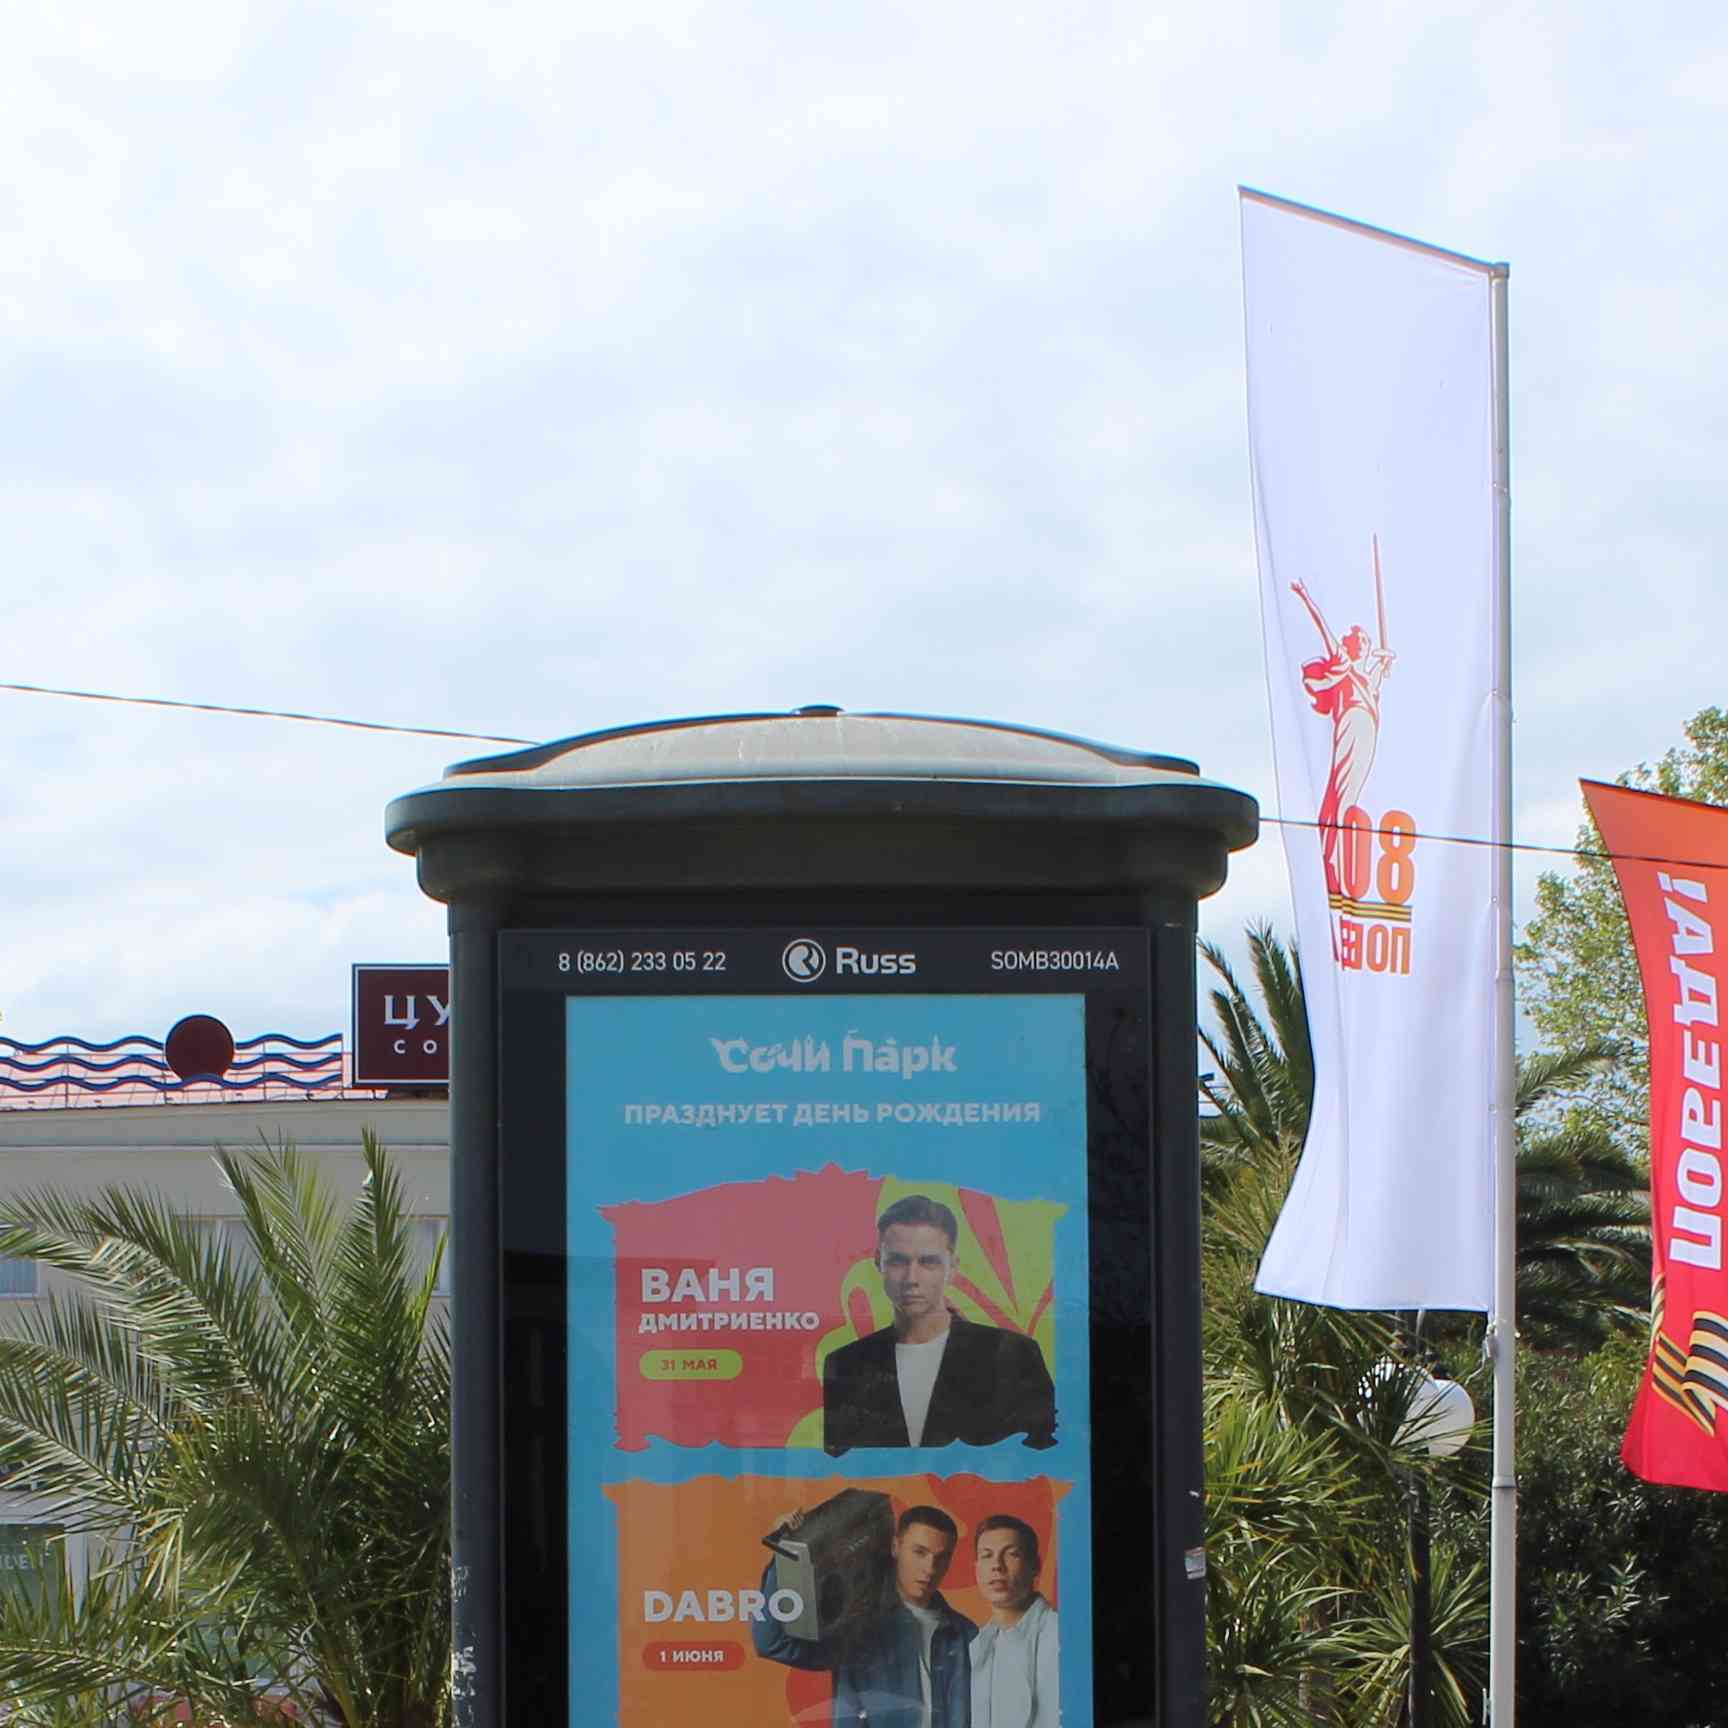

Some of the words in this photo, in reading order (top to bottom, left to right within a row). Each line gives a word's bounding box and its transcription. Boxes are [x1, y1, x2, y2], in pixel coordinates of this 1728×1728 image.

[558, 952, 571, 972] 8
[576, 951, 624, 973] (862)
[631, 952, 667, 971] 233
[672, 952, 697, 971] 05
[702, 952, 727, 971] 22
[835, 947, 916, 975] Russ
[991, 950, 1120, 971] SOMB30014A
[384, 994, 449, 1031] ЦУ
[393, 1039, 438, 1055] СО
[624, 1103, 788, 1127] ПРАЗДНУЕТ
[793, 1103, 870, 1127] ДЕНЬ
[876, 1102, 1042, 1126] РОЖДЕНИЯ
[640, 1268, 775, 1303] ВАНЯ
[638, 1312, 820, 1335] ДМИТРИЕНКО
[661, 1358, 676, 1372] 31
[682, 1358, 718, 1372] МАЯ
[643, 1588, 805, 1623] DABRO
[659, 1650, 667, 1663] 1
[672, 1649, 725, 1663] ИЮНЯ
